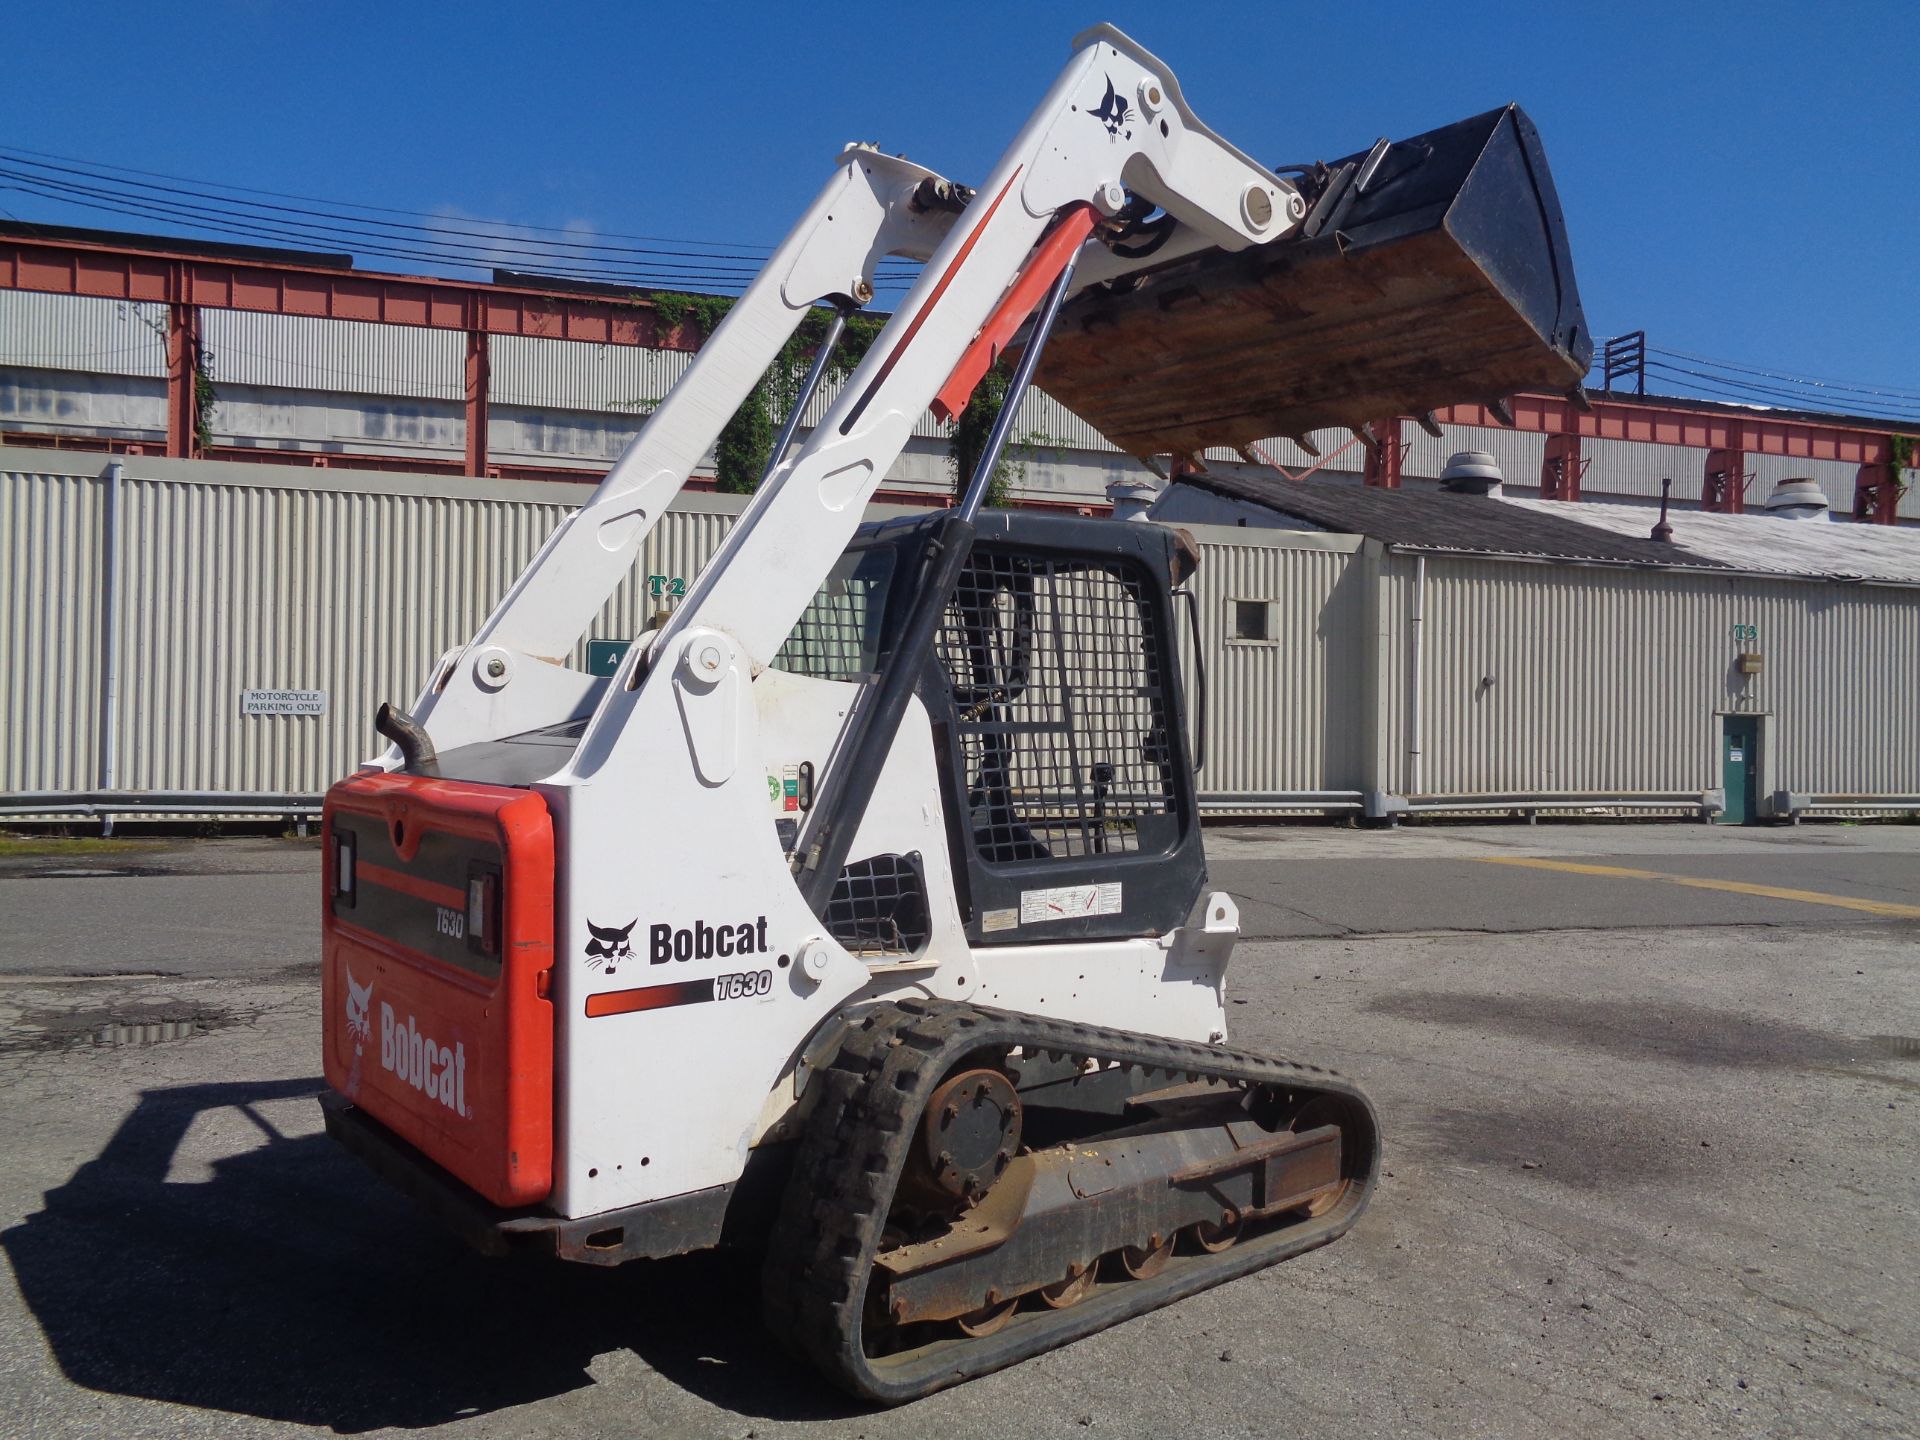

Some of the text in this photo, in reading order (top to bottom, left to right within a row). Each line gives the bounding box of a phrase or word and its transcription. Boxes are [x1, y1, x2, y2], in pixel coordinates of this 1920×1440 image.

[647, 574, 686, 596] T2
[1733, 623, 1758, 641] T3
[247, 702, 323, 712] PARKING ONLY
[251, 692, 319, 701] MOTORCYCLE
[436, 906, 464, 939] T630
[650, 916, 768, 965] Bobcat
[717, 969, 773, 1001] T630
[380, 1000, 467, 1118] Bobcat
